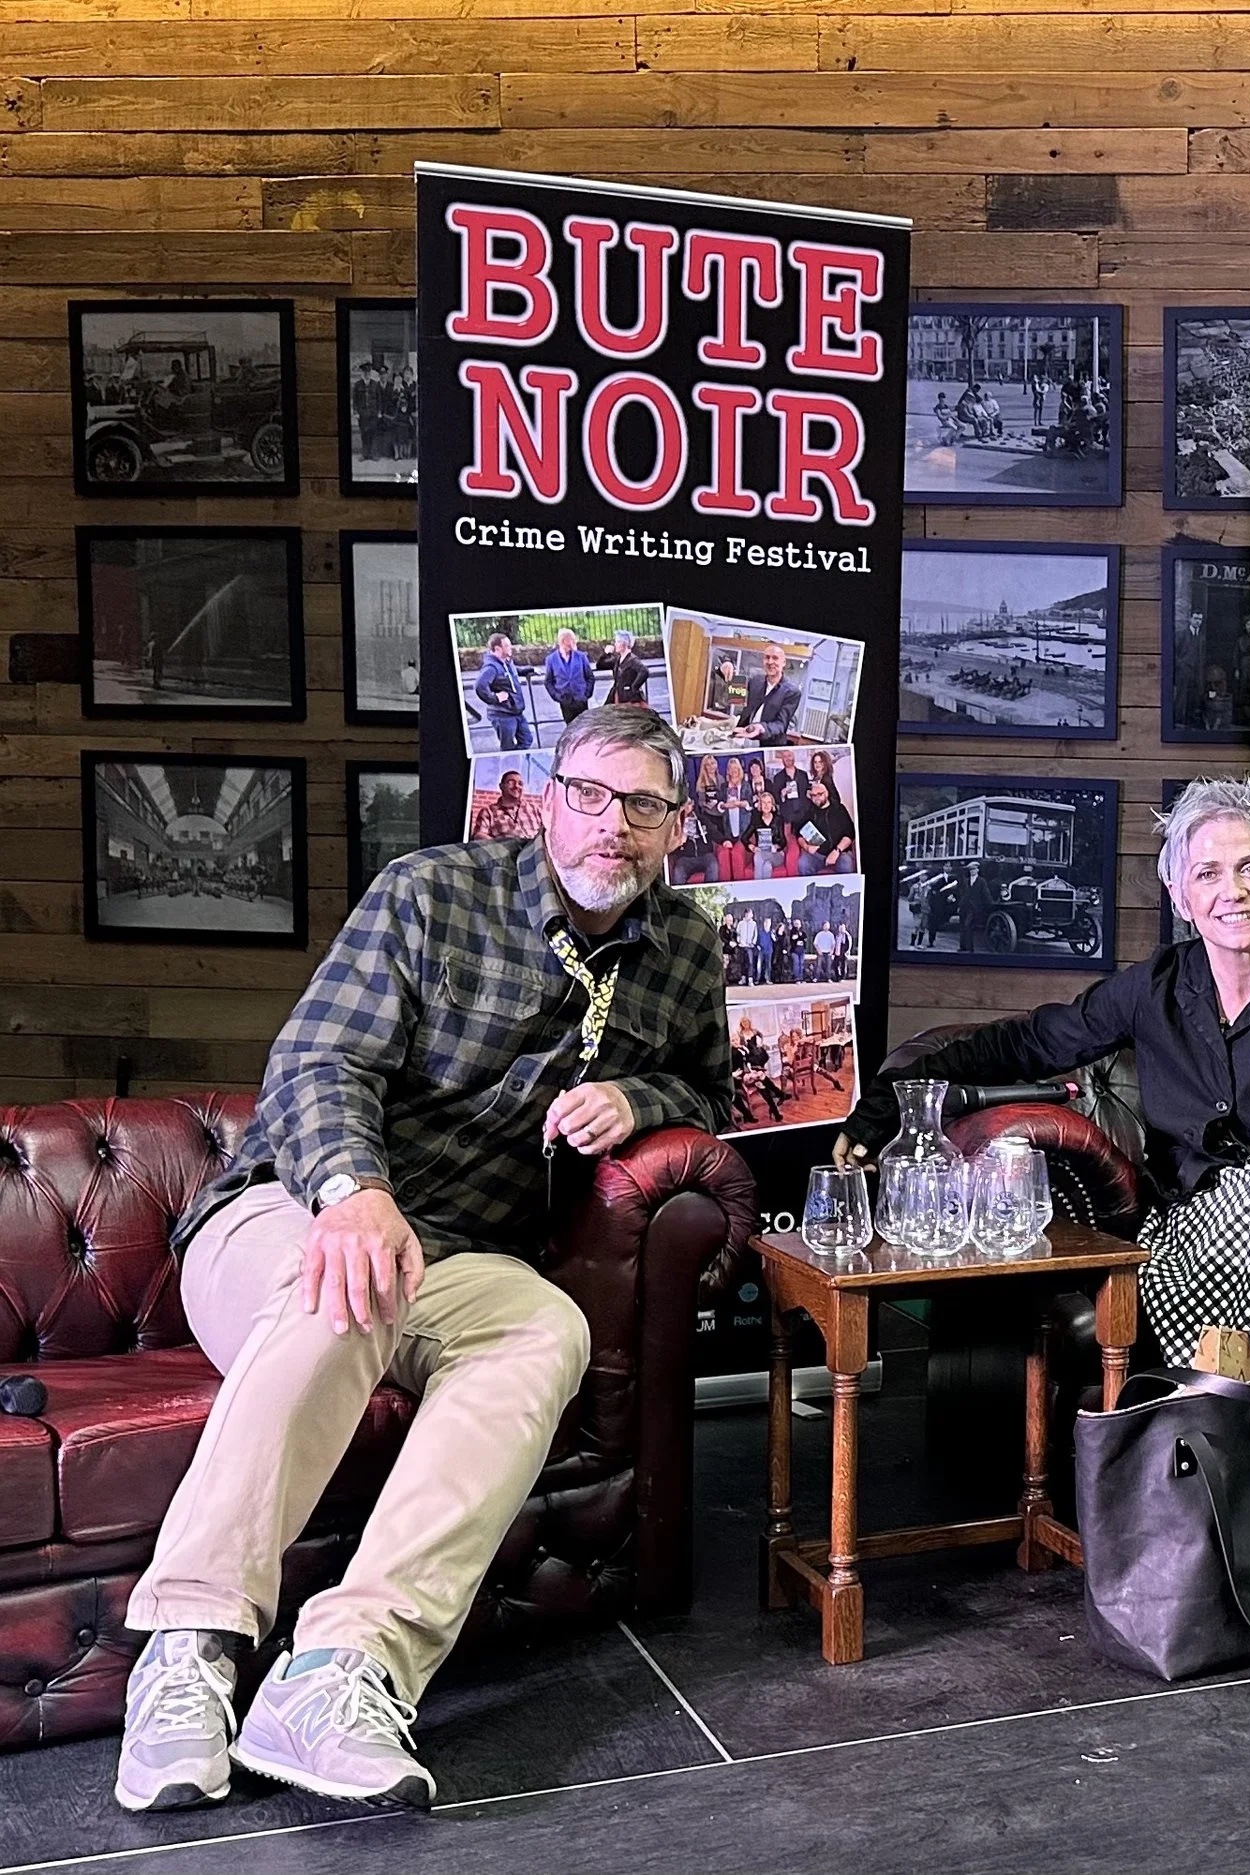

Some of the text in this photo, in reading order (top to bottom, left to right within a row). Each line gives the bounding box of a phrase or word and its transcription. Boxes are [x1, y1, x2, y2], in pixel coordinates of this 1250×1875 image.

[446, 203, 884, 381] BUTE
[459, 358, 876, 527] NOIR
[455, 516, 872, 573] Crime Writing Festival
